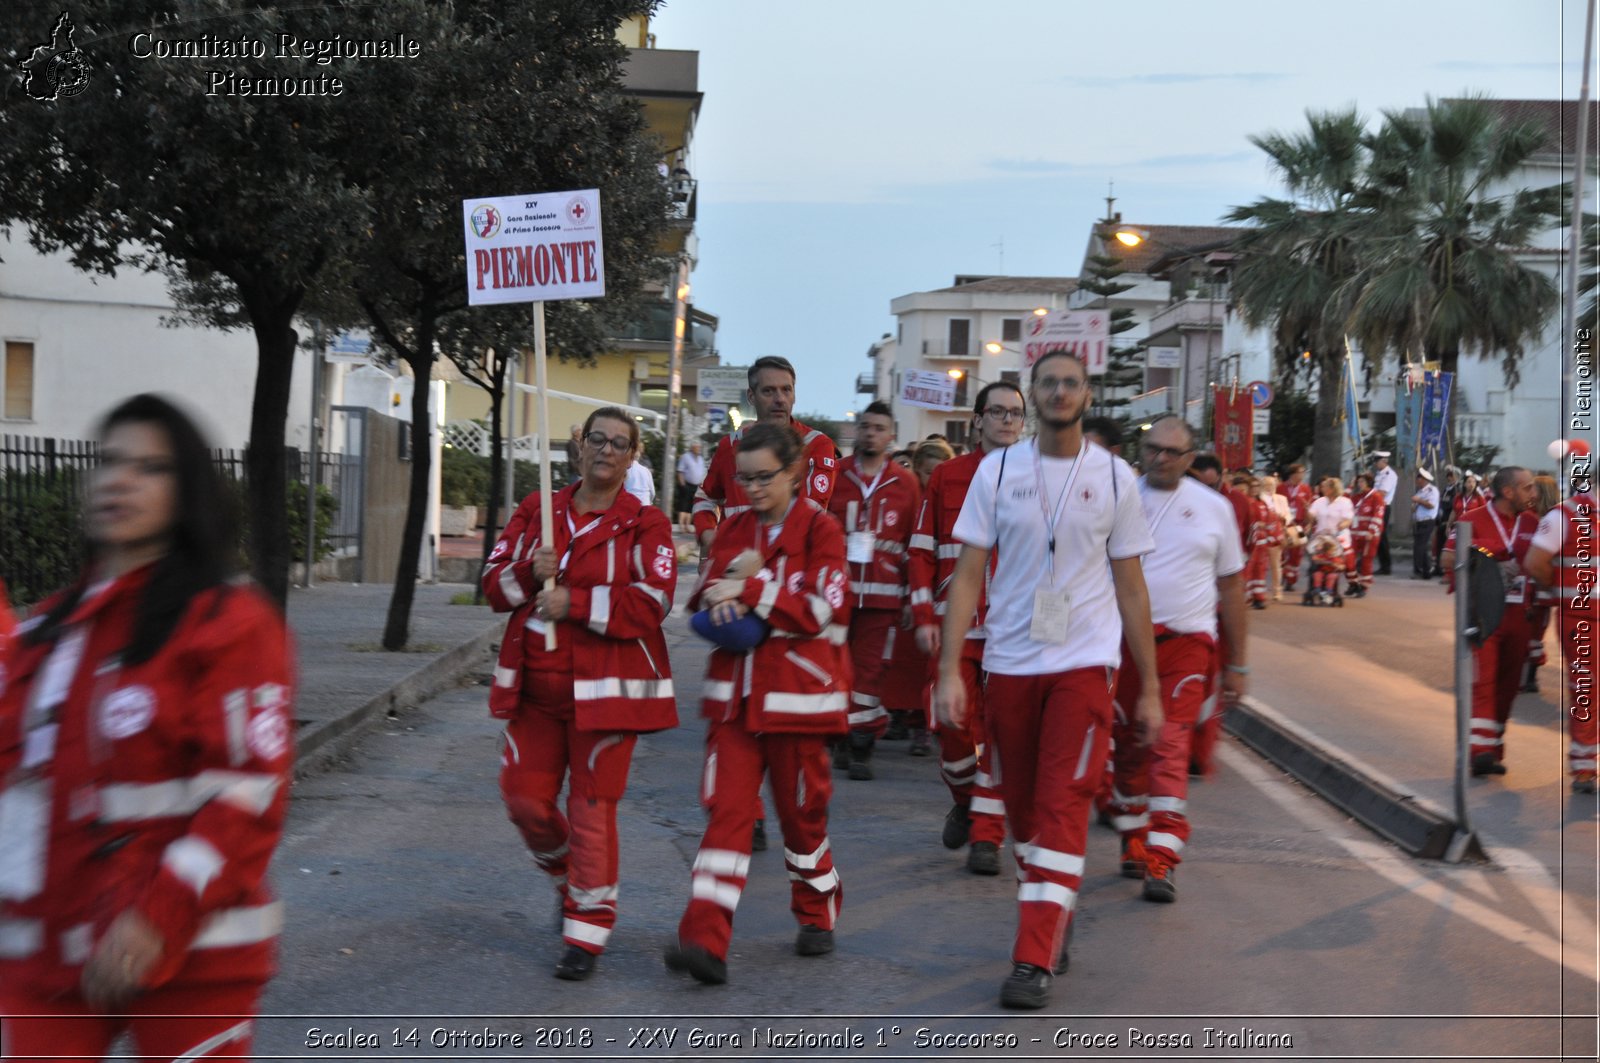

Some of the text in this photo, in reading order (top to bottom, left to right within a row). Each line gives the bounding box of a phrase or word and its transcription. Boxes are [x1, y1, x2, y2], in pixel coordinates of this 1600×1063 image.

[525, 200, 538, 209] XXV
[525, 212, 557, 221] Nazionale
[532, 224, 561, 232] Soccorso
[474, 240, 598, 290] PIEMONTE
